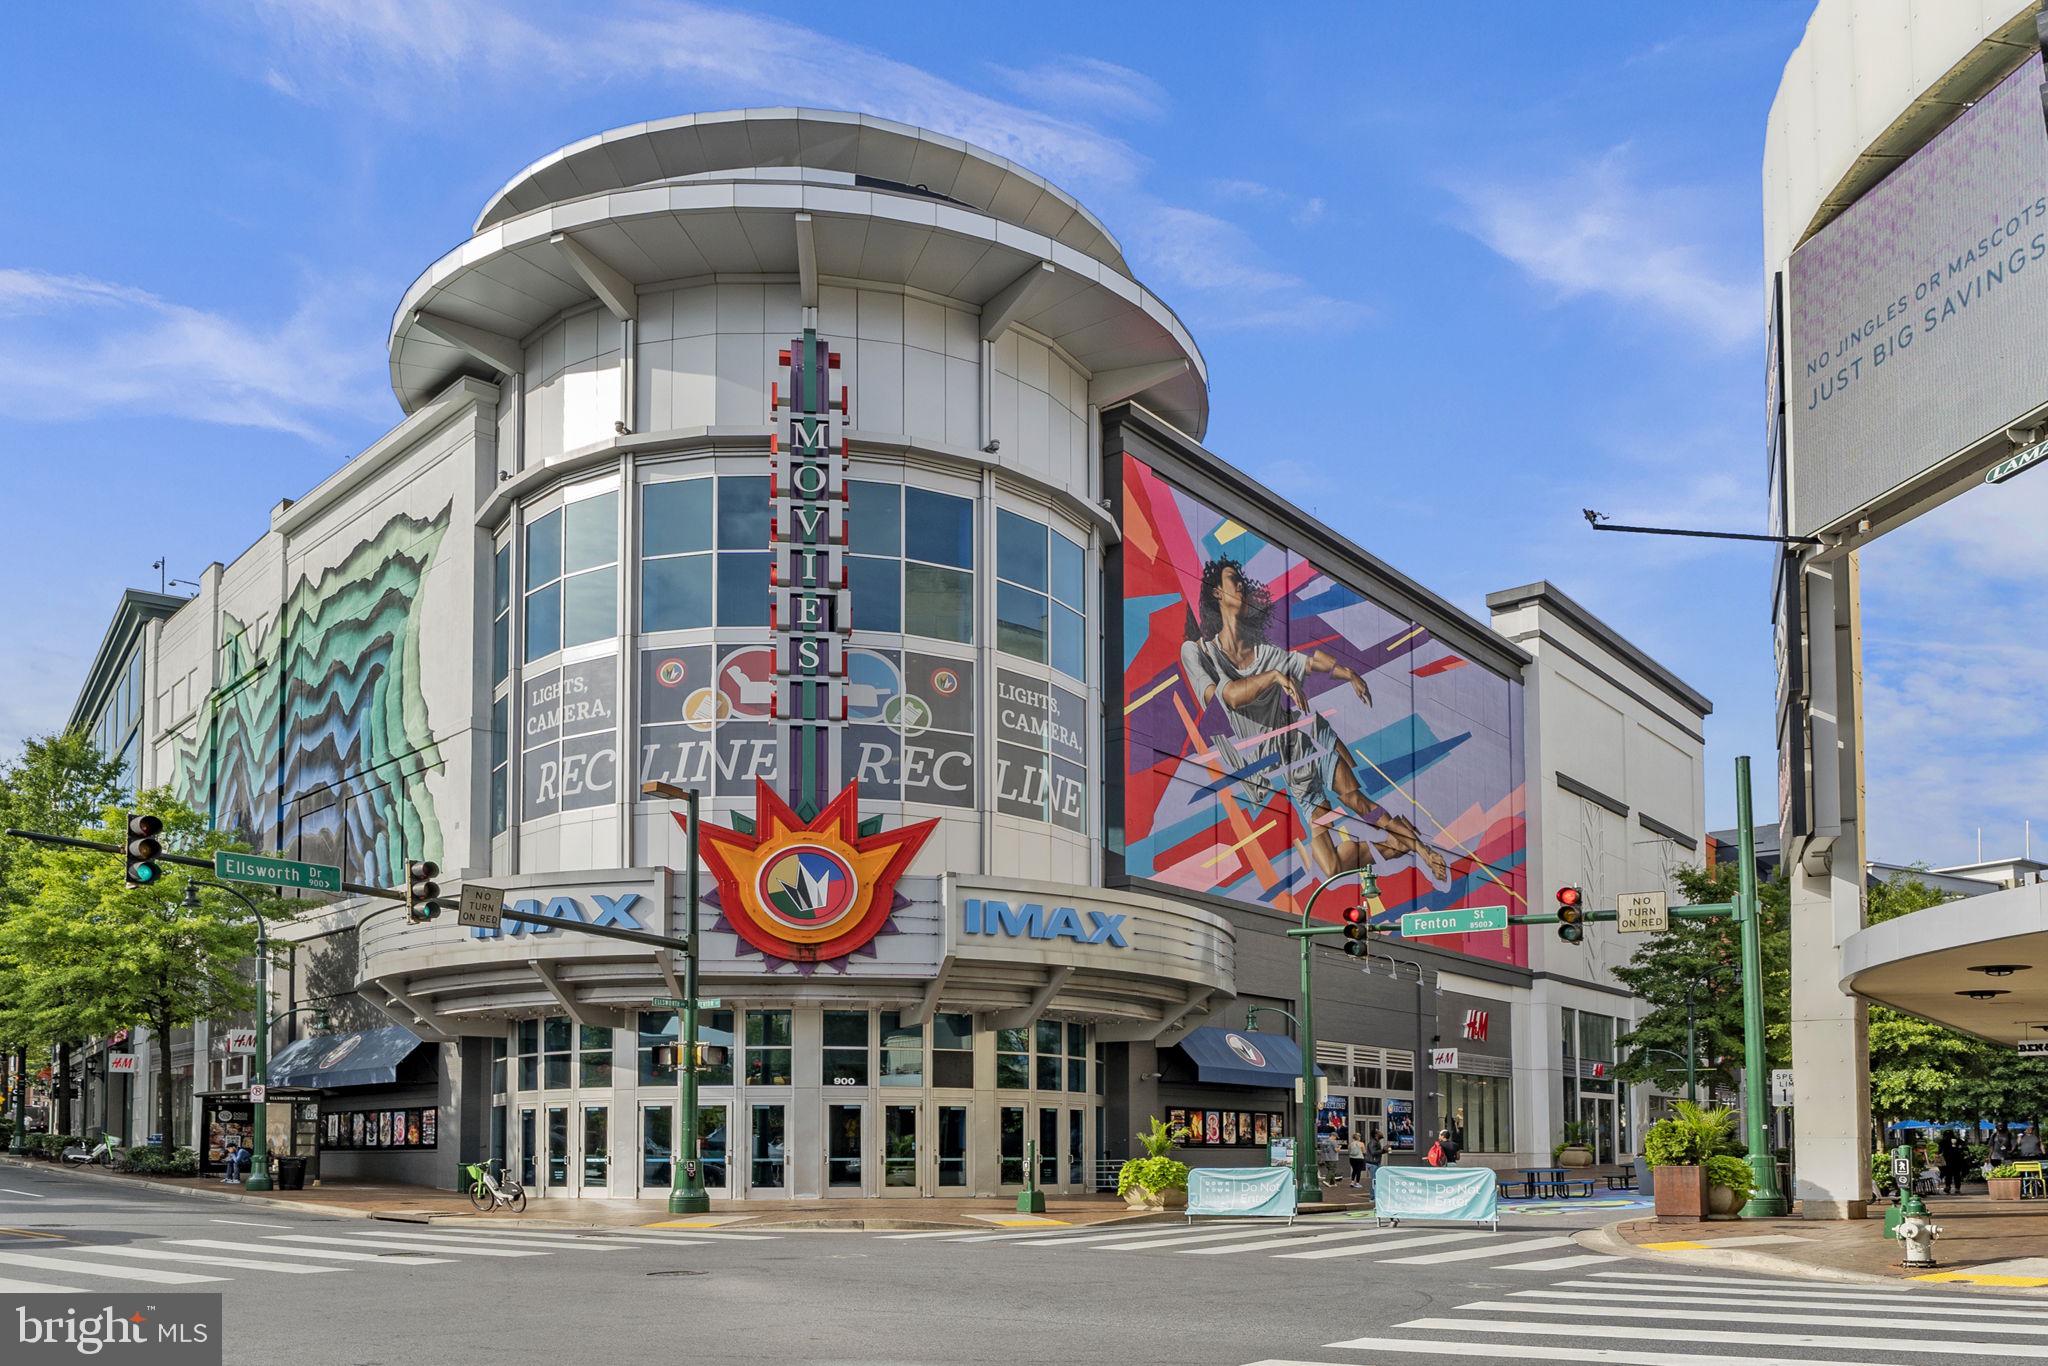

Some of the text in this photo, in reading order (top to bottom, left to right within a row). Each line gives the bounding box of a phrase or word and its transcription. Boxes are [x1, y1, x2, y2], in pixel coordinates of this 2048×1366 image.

[1807, 197, 2047, 378] NO JINGLES OR MASCOTS
[1808, 356, 1863, 410] JUST
[1873, 325, 1914, 367] BIG
[1925, 233, 2047, 333] SAVINGS
[792, 421, 829, 669] MOVIES
[532, 676, 588, 706] LIGHTS,
[998, 682, 1060, 717] LIGHTS,
[527, 698, 611, 735] CAMERA,
[1001, 709, 1083, 754] CAMERA,
[226, 859, 322, 882] Ellsworth Dr
[308, 879, 324, 888] 900
[475, 891, 491, 901] NO
[1633, 897, 1651, 906] NO
[469, 901, 494, 912] TURN
[1627, 907, 1656, 917] TURN
[463, 912, 498, 924] ON RED
[965, 898, 1128, 948] IMAX
[1414, 910, 1485, 931] Fenton St
[1621, 917, 1663, 928] ON RED
[1470, 921, 1488, 929] 8500
[111, 1057, 133, 1069] H&M
[1435, 1052, 1455, 1065] H&M
[833, 1077, 856, 1086] 900
[1241, 1182, 1280, 1193] Do Not
[1435, 1183, 1480, 1195] Do Not
[1435, 1196, 1468, 1207] Enter
